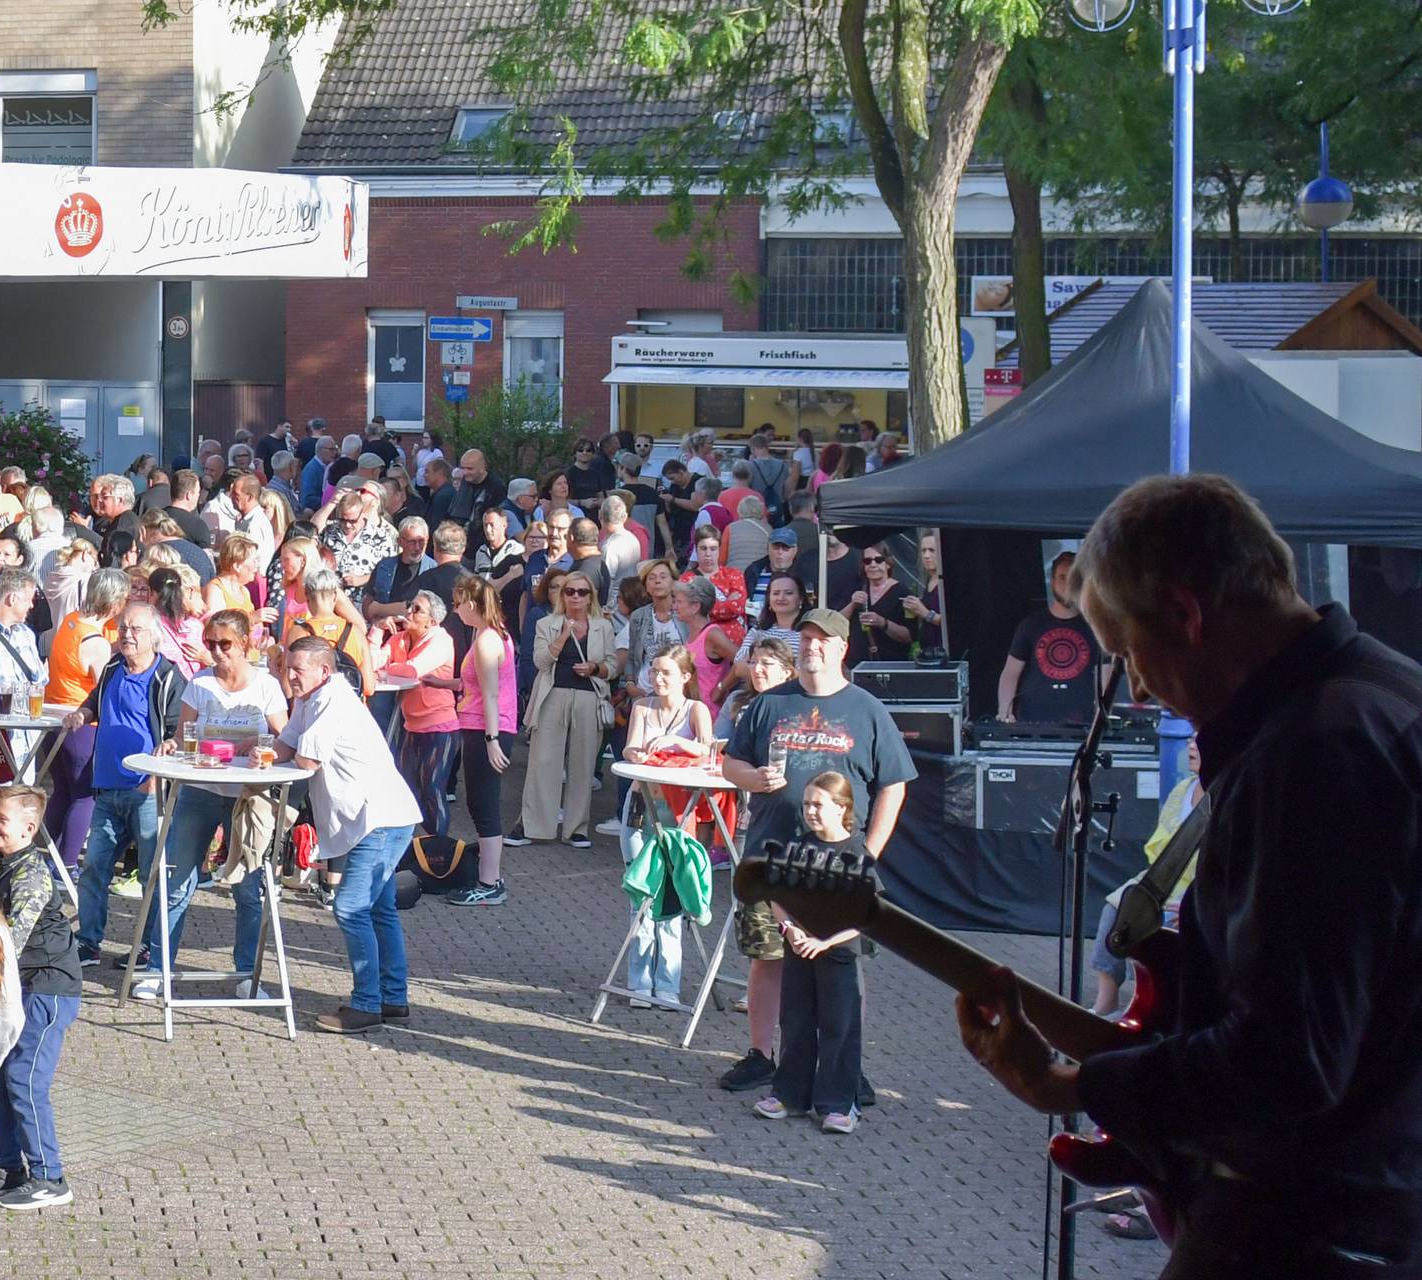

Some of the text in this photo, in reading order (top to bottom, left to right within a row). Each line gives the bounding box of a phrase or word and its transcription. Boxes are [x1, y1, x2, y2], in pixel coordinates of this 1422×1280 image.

[231, 182, 322, 241] Pilsener
[634, 348, 817, 360] Räucherwaren Frischfisch
[815, 732, 848, 748] Rock
[990, 770, 1014, 779] THON
